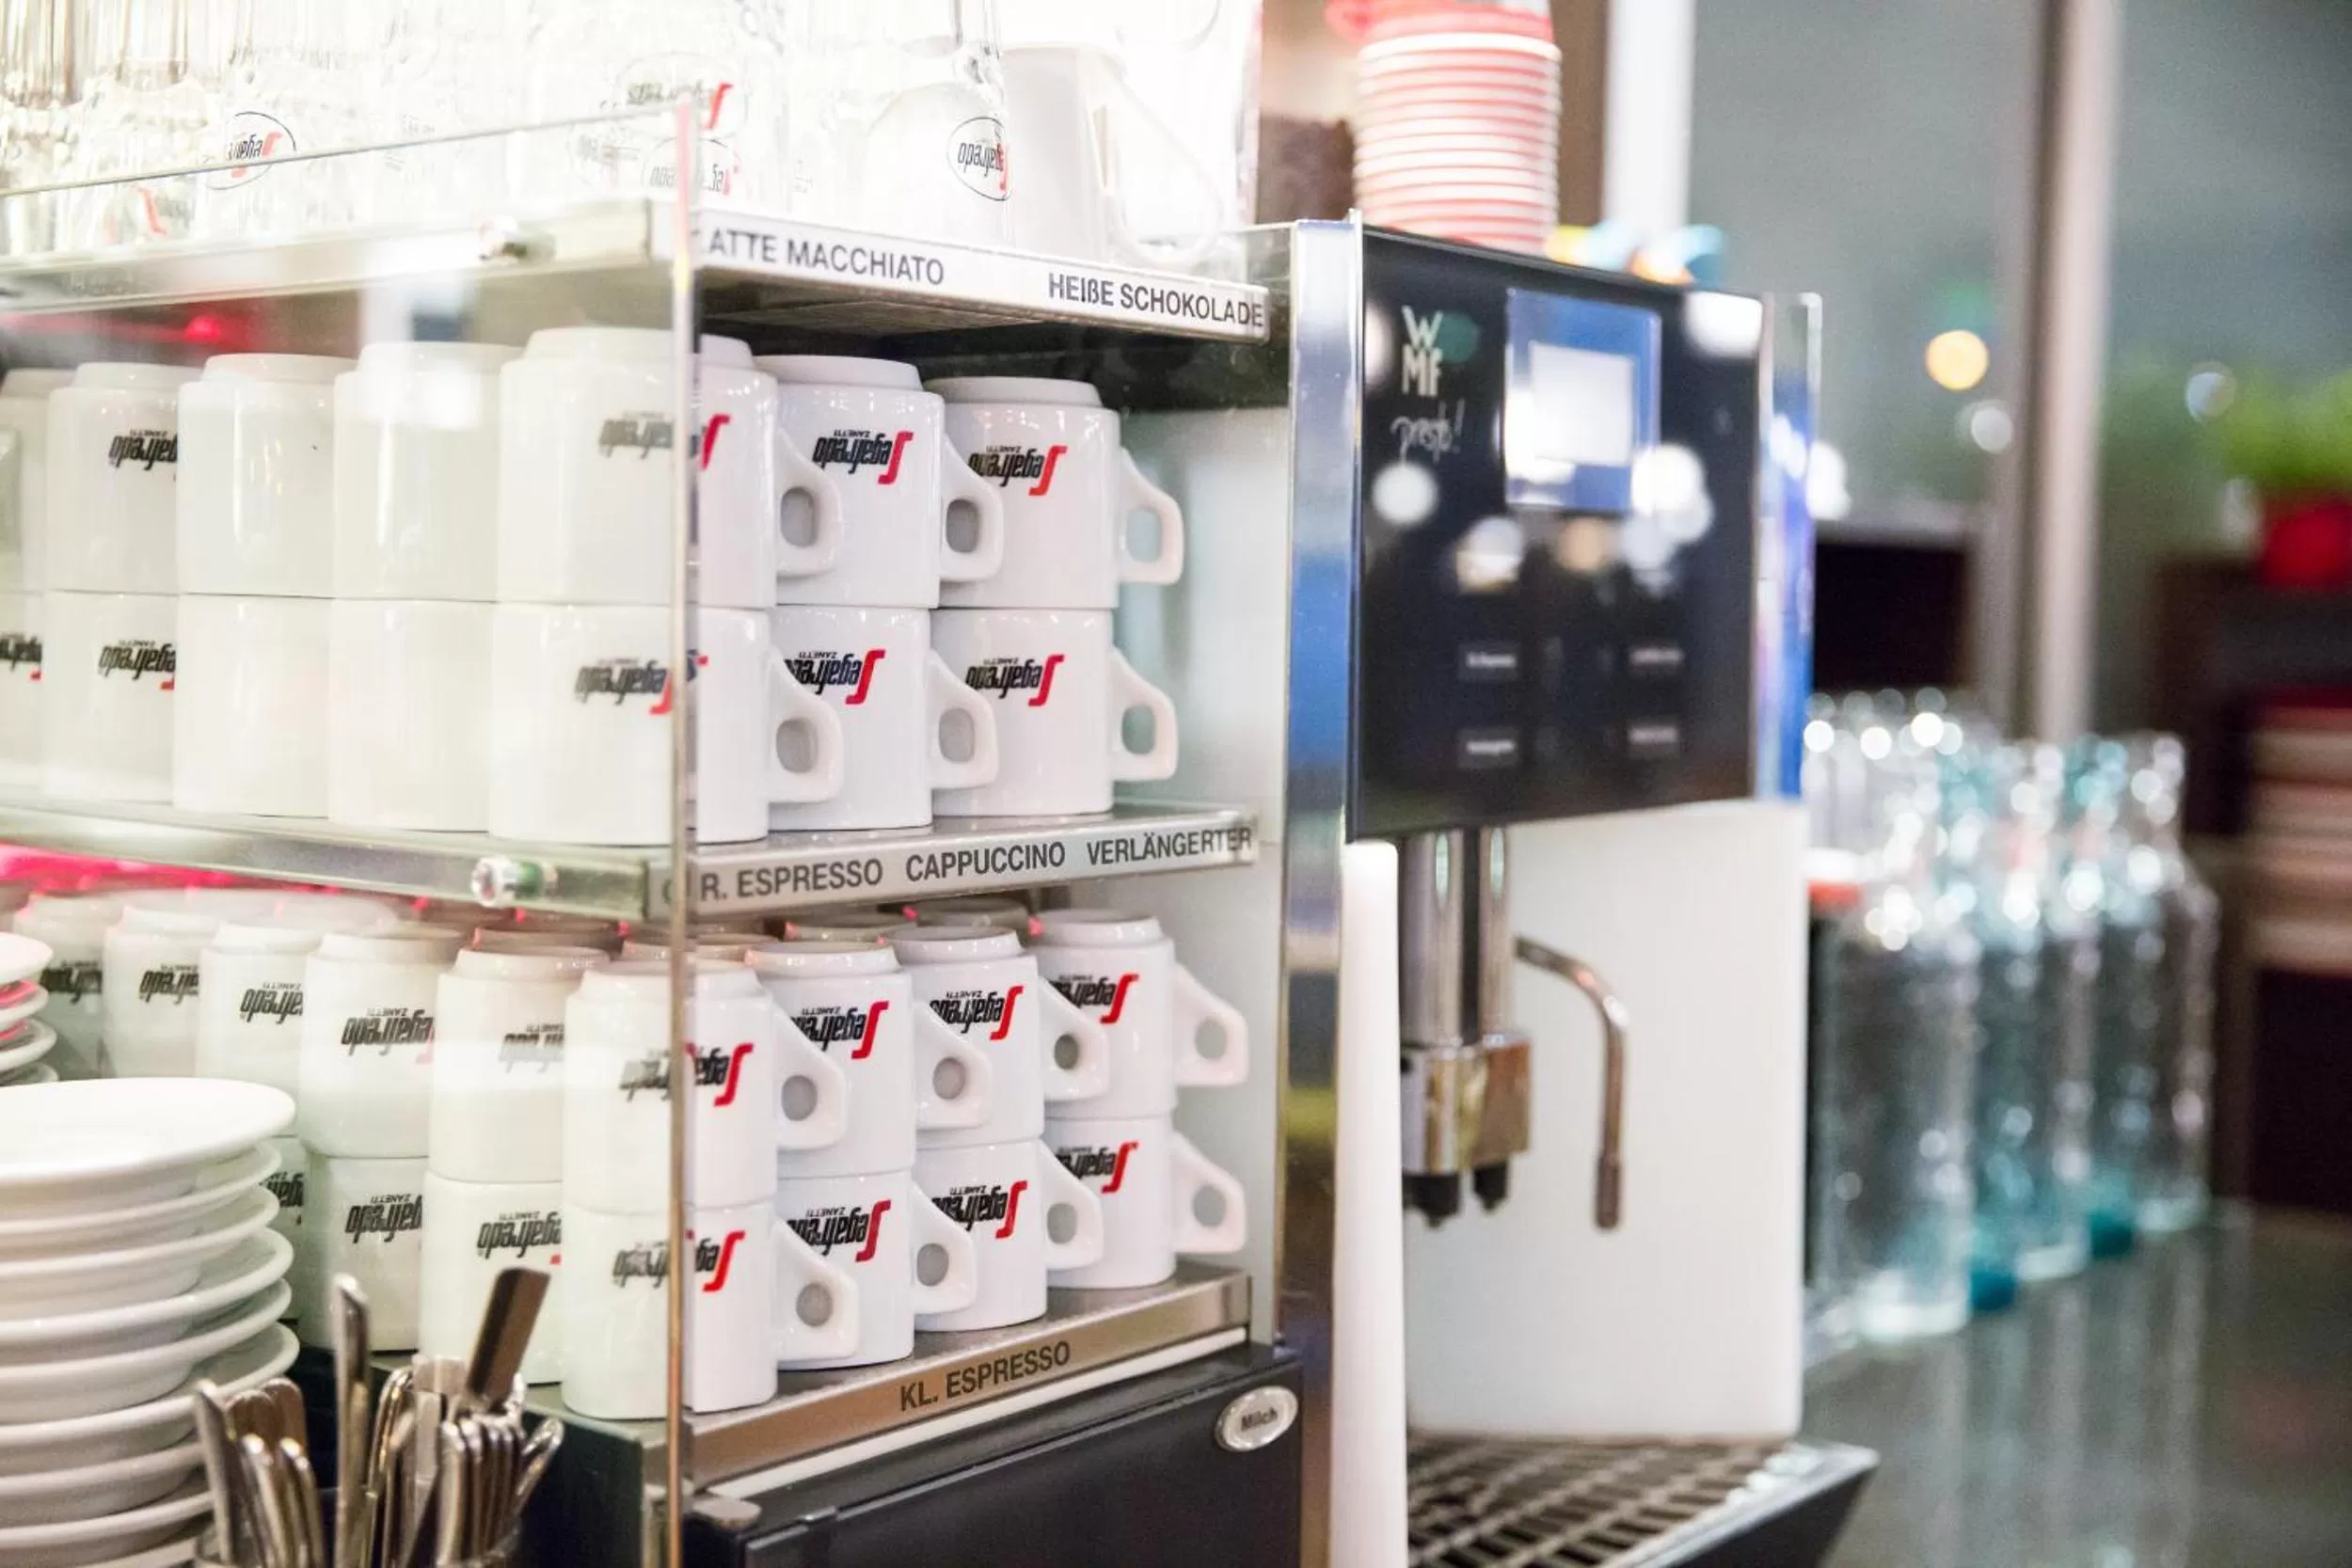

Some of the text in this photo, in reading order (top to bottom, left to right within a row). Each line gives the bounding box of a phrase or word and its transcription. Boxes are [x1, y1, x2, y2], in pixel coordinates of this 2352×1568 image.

[707, 229, 946, 286] ATTE MACCHIATO
[1117, 283, 1264, 327] SCHOKOLADE
[812, 432, 914, 485] Segafredo
[737, 860, 882, 898] ESPRESSO
[905, 842, 1066, 882] CAPPUCCINO
[1086, 827, 1252, 865] VERLÄNGERTER
[900, 1340, 1070, 1412] KL. ESPRESSO
